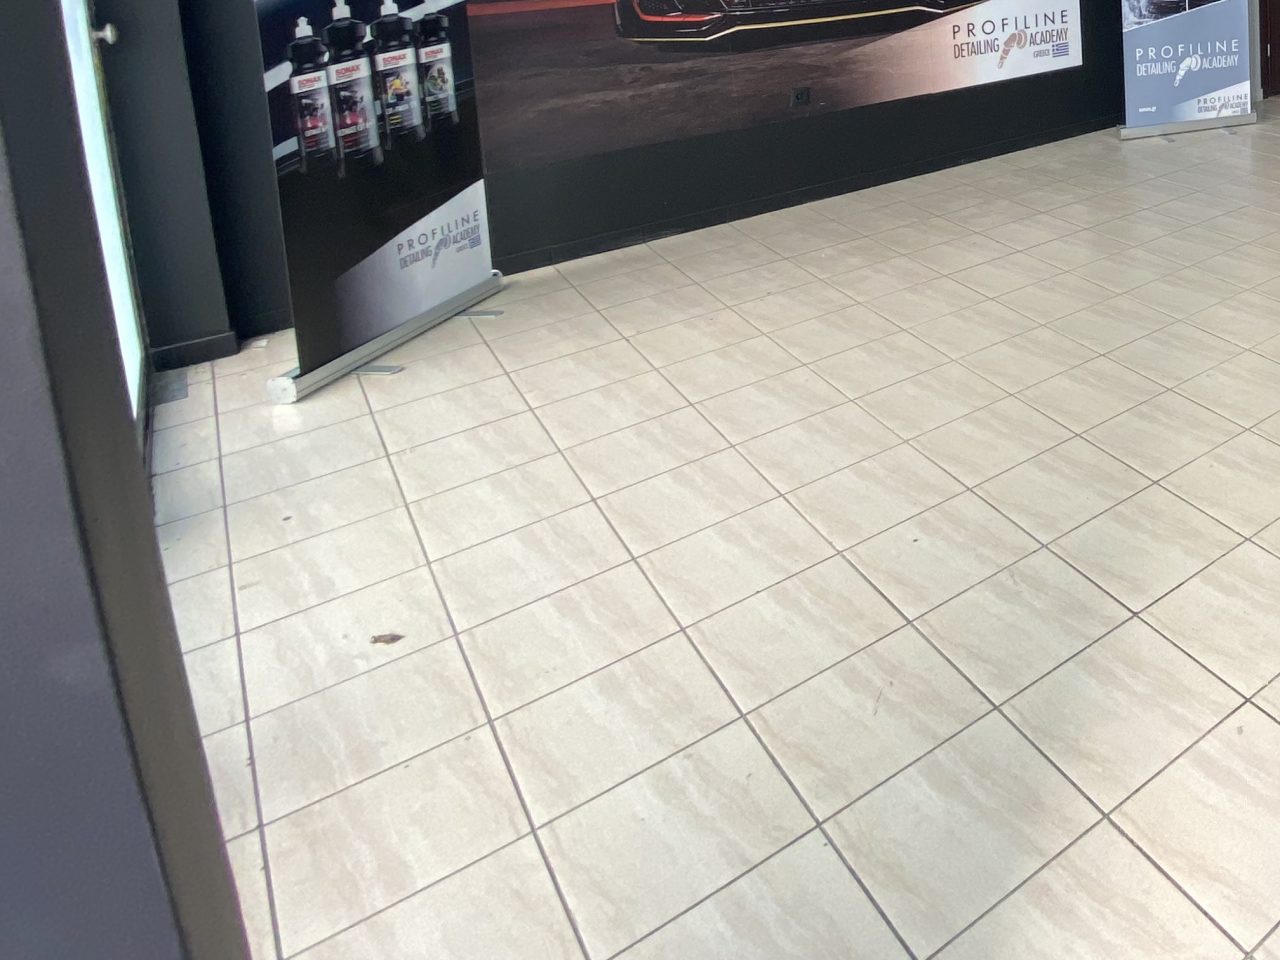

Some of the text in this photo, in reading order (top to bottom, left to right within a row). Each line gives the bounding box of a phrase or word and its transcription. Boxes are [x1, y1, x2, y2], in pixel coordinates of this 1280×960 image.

[952, 9, 1069, 40] PROFILINE
[953, 27, 1069, 59] DETAILING ACADEMY
[1135, 39, 1240, 61] PROFILINE
[382, 52, 407, 64] SONAX
[1136, 54, 1239, 77] DETAILING ACADEMY
[335, 64, 361, 77] SONAX
[1197, 93, 1248, 105] PROFILINE
[397, 210, 480, 255] PROFILINE
[399, 246, 433, 270] DETAILING
[452, 224, 480, 245] ACADEMY
